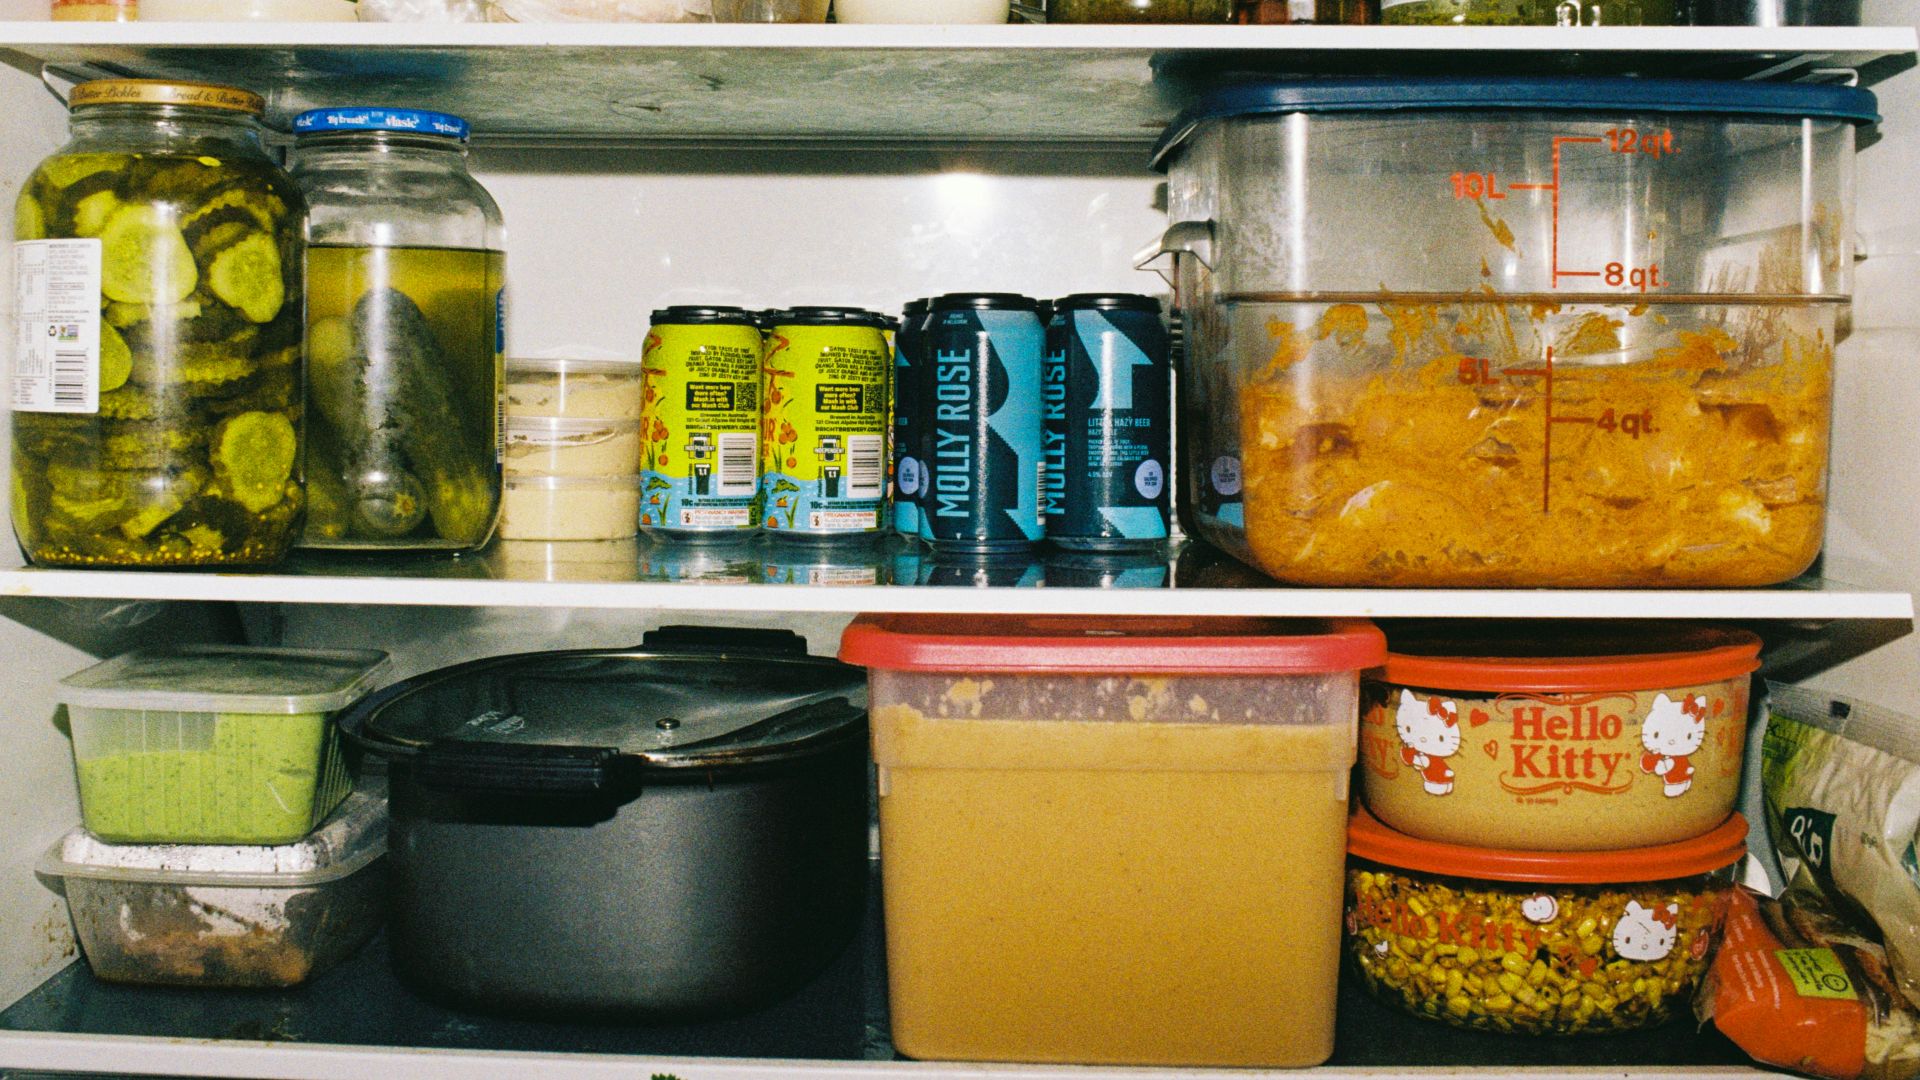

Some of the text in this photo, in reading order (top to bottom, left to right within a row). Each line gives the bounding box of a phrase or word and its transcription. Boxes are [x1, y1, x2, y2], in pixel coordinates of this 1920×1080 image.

[1450, 172, 1506, 200] 10L
[937, 349, 970, 420] ROSE
[1114, 418, 1133, 426] HAZY
[1135, 418, 1150, 426] BEER
[937, 428, 970, 517] MOLLY
[1510, 706, 1622, 741] Hello
[1355, 890, 1541, 960] Hello Kitty
